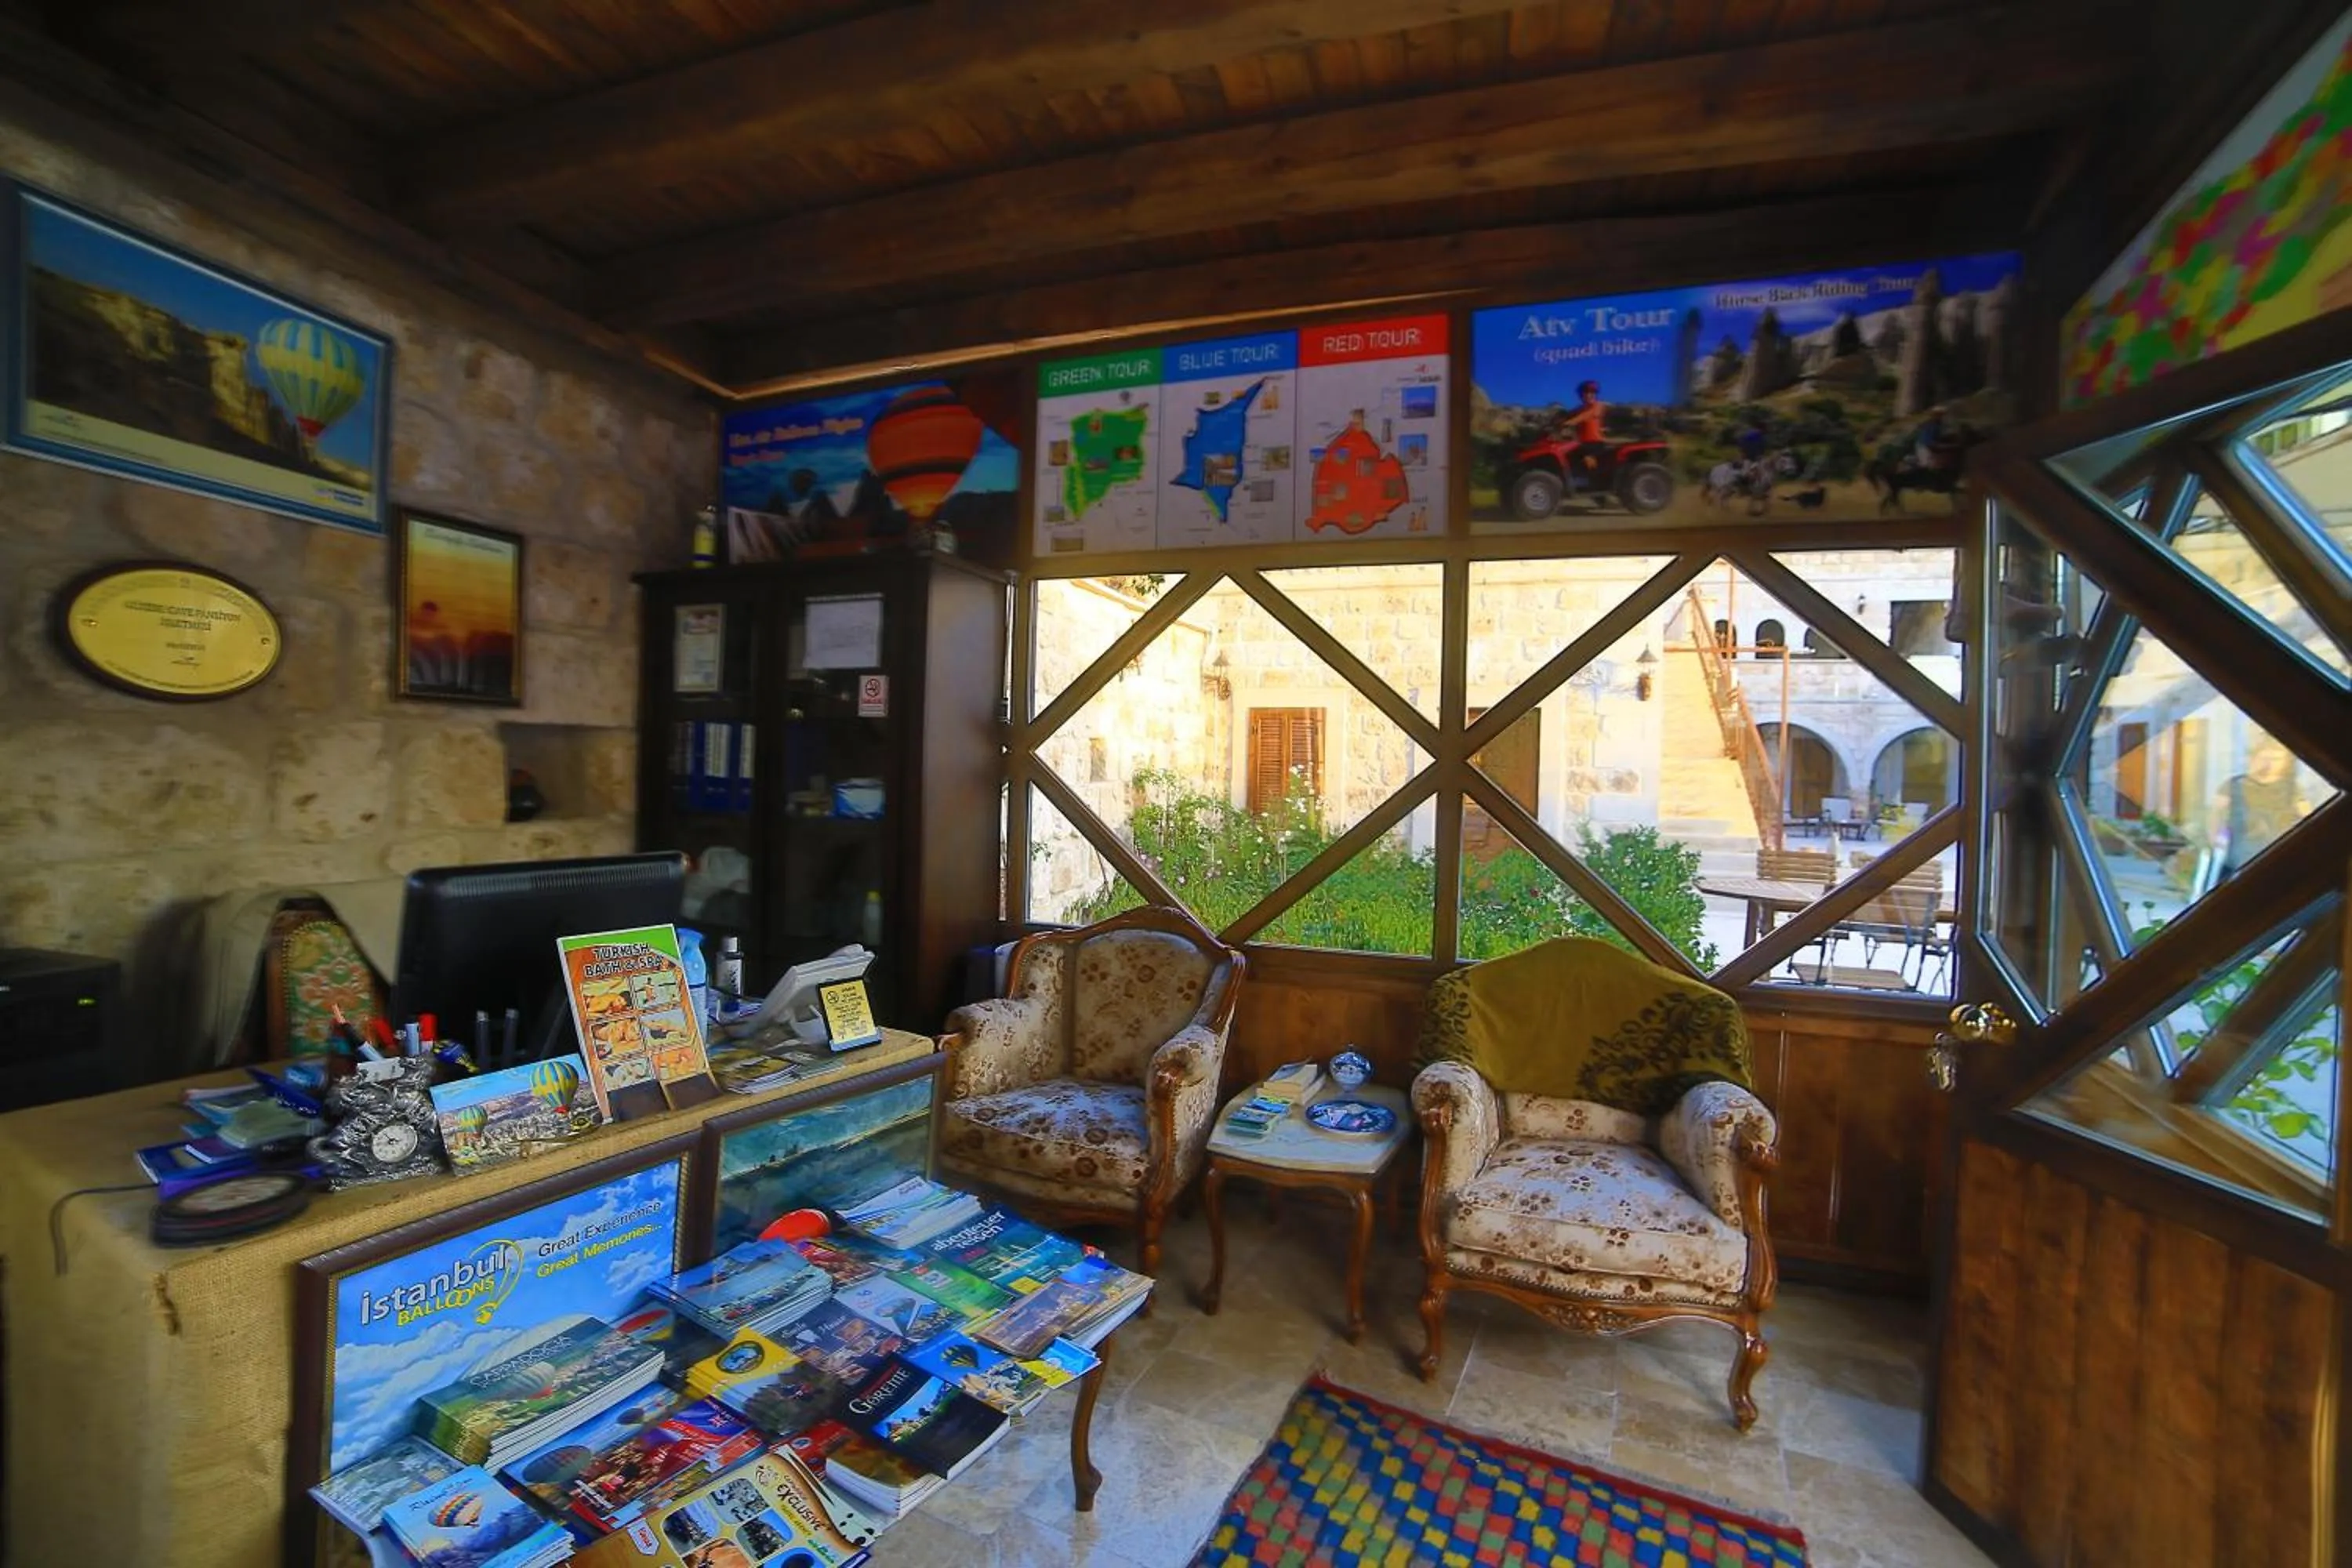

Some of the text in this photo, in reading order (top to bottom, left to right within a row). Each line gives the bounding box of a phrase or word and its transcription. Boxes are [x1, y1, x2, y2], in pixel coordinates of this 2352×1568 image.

[1518, 307, 1676, 339] Atv Tour
[1323, 328, 1421, 353] RED TOUR
[1179, 343, 1279, 370] BLUE TOUR
[1048, 359, 1151, 388] GREEN TOUR
[584, 960, 622, 978] BATH
[638, 953, 665, 968] SPA
[592, 942, 650, 961] TURKISH
[539, 1201, 662, 1258] Great Experience
[931, 1210, 1006, 1252] abenteuer
[536, 1252, 579, 1279] Great
[397, 1276, 495, 1327] BALLOONS
